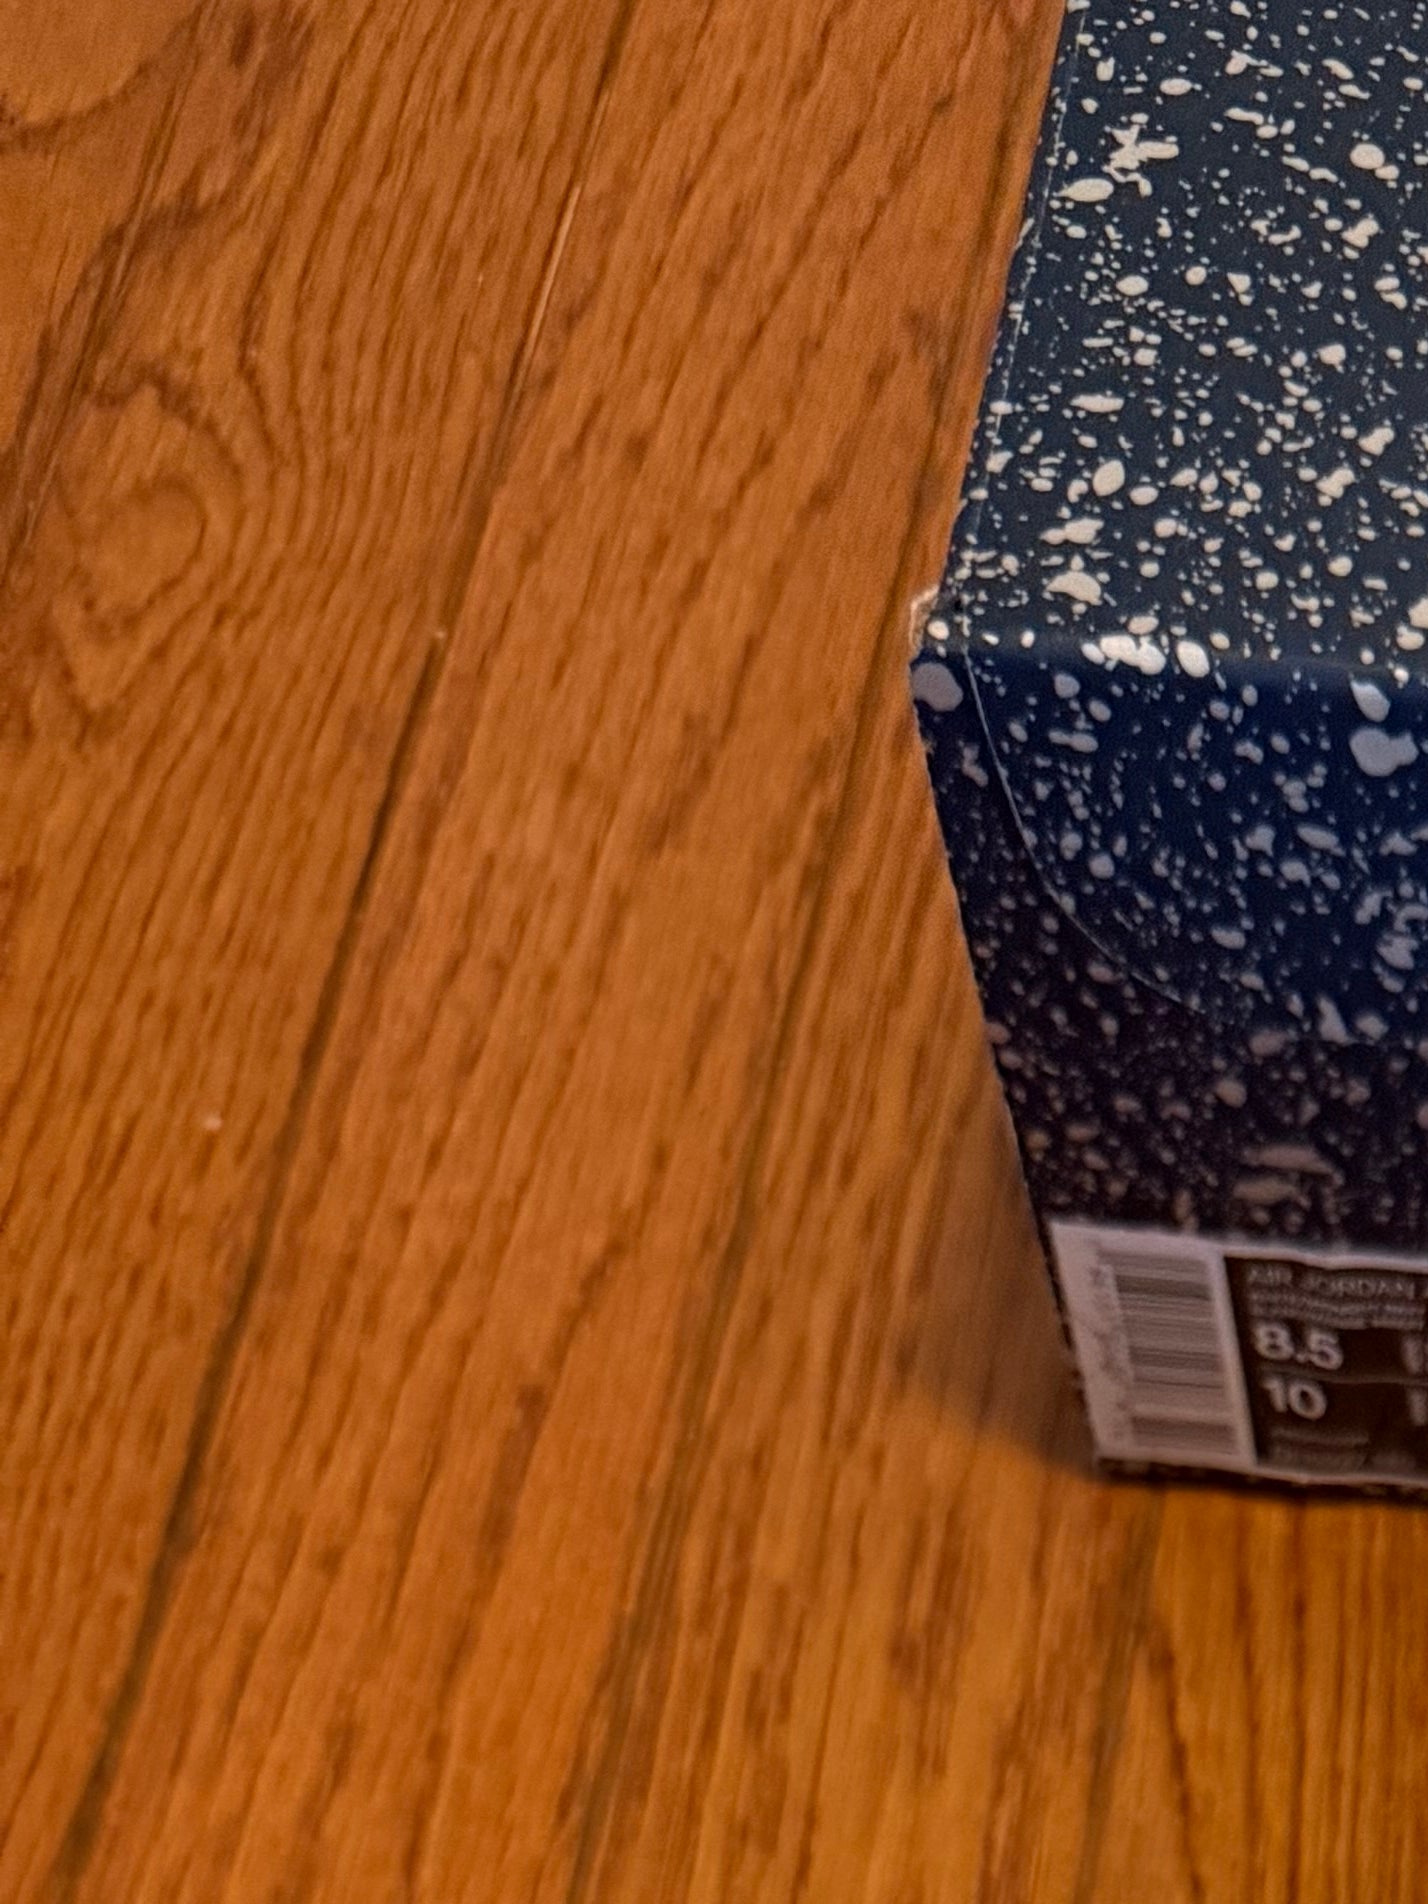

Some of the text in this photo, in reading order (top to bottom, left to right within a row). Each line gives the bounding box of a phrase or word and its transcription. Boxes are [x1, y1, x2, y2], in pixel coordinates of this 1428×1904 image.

[1300, 1269, 1416, 1300] JORDAN
[1254, 1323, 1344, 1371] 8.5
[1262, 1378, 1328, 1421] 10
